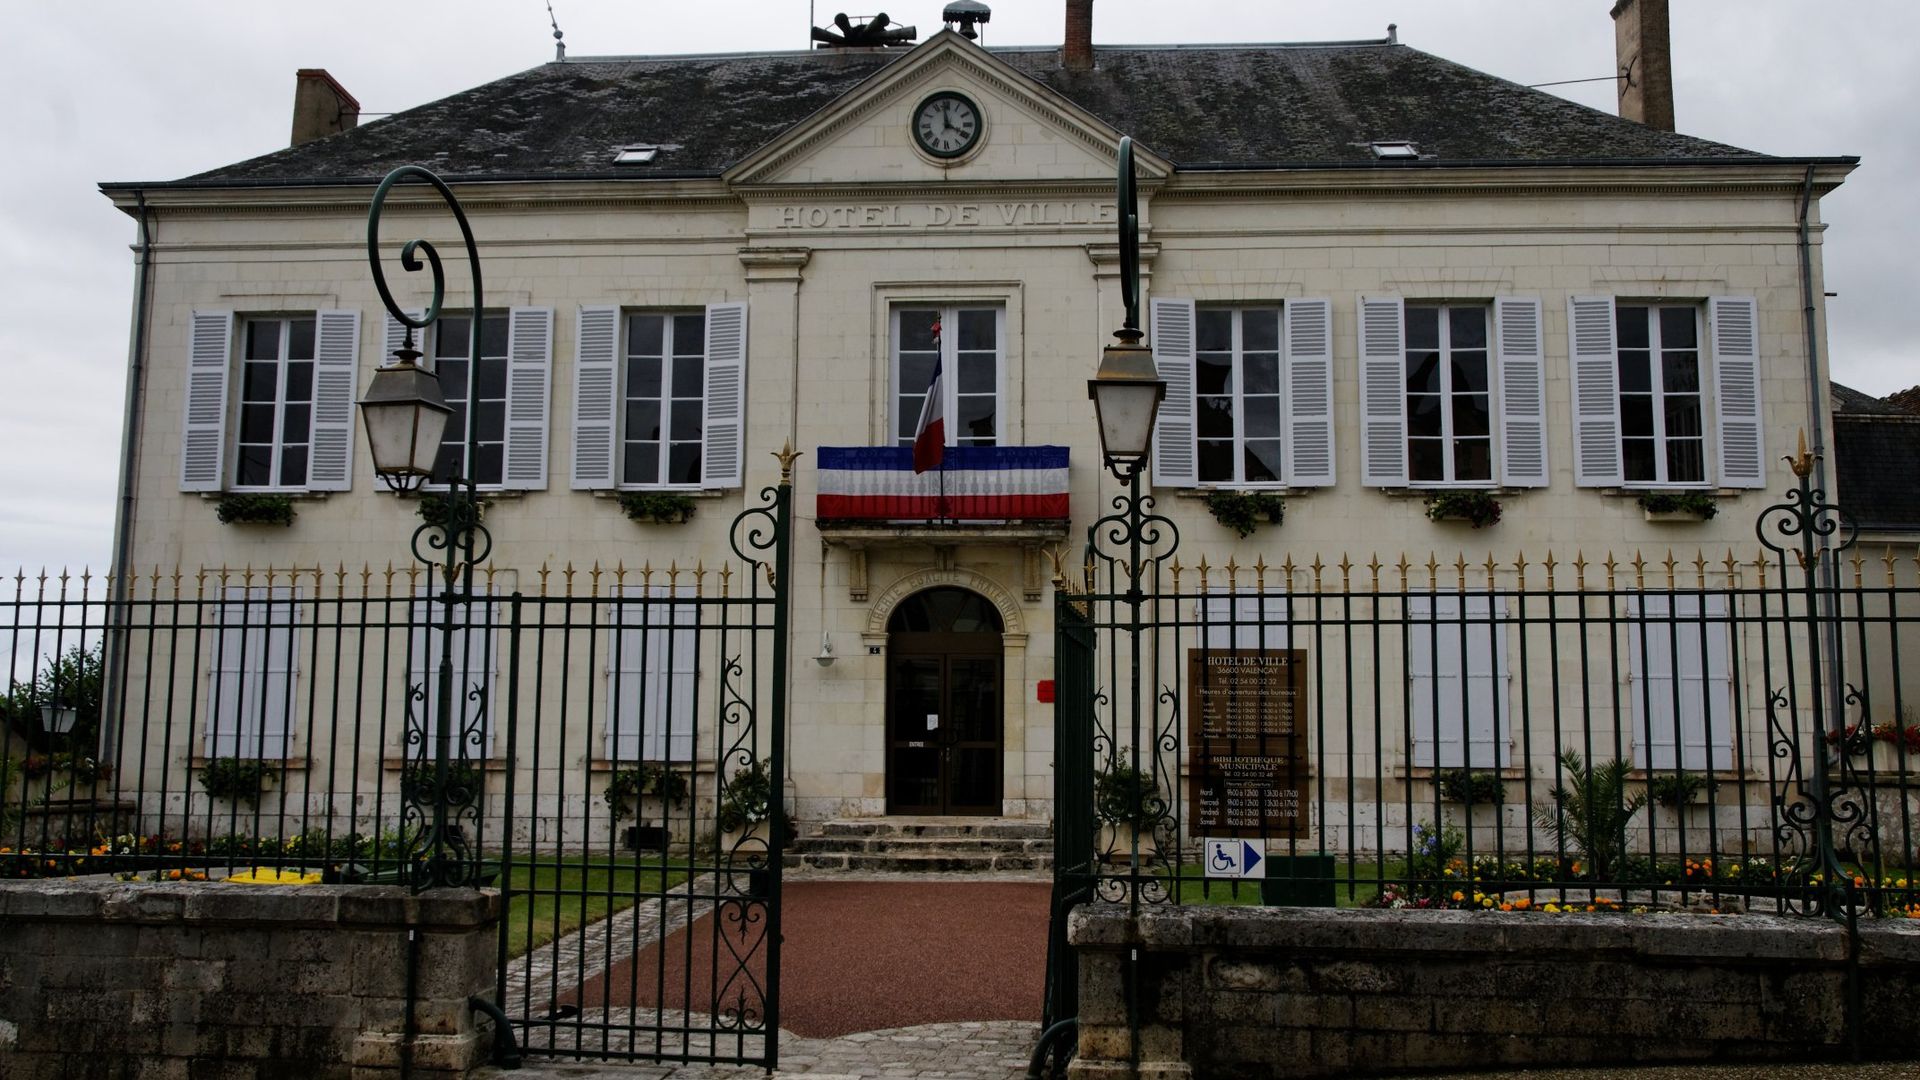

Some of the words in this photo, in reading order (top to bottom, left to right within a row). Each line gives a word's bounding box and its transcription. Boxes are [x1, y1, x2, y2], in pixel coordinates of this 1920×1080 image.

[775, 205, 911, 229] HOTEL
[926, 204, 981, 227] DE
[996, 202, 1118, 226] VILLE
[1207, 656, 1241, 666] HOTEL
[1243, 656, 1256, 666] DE
[1259, 657, 1288, 666] VILLE
[1217, 666, 1239, 674] 36600
